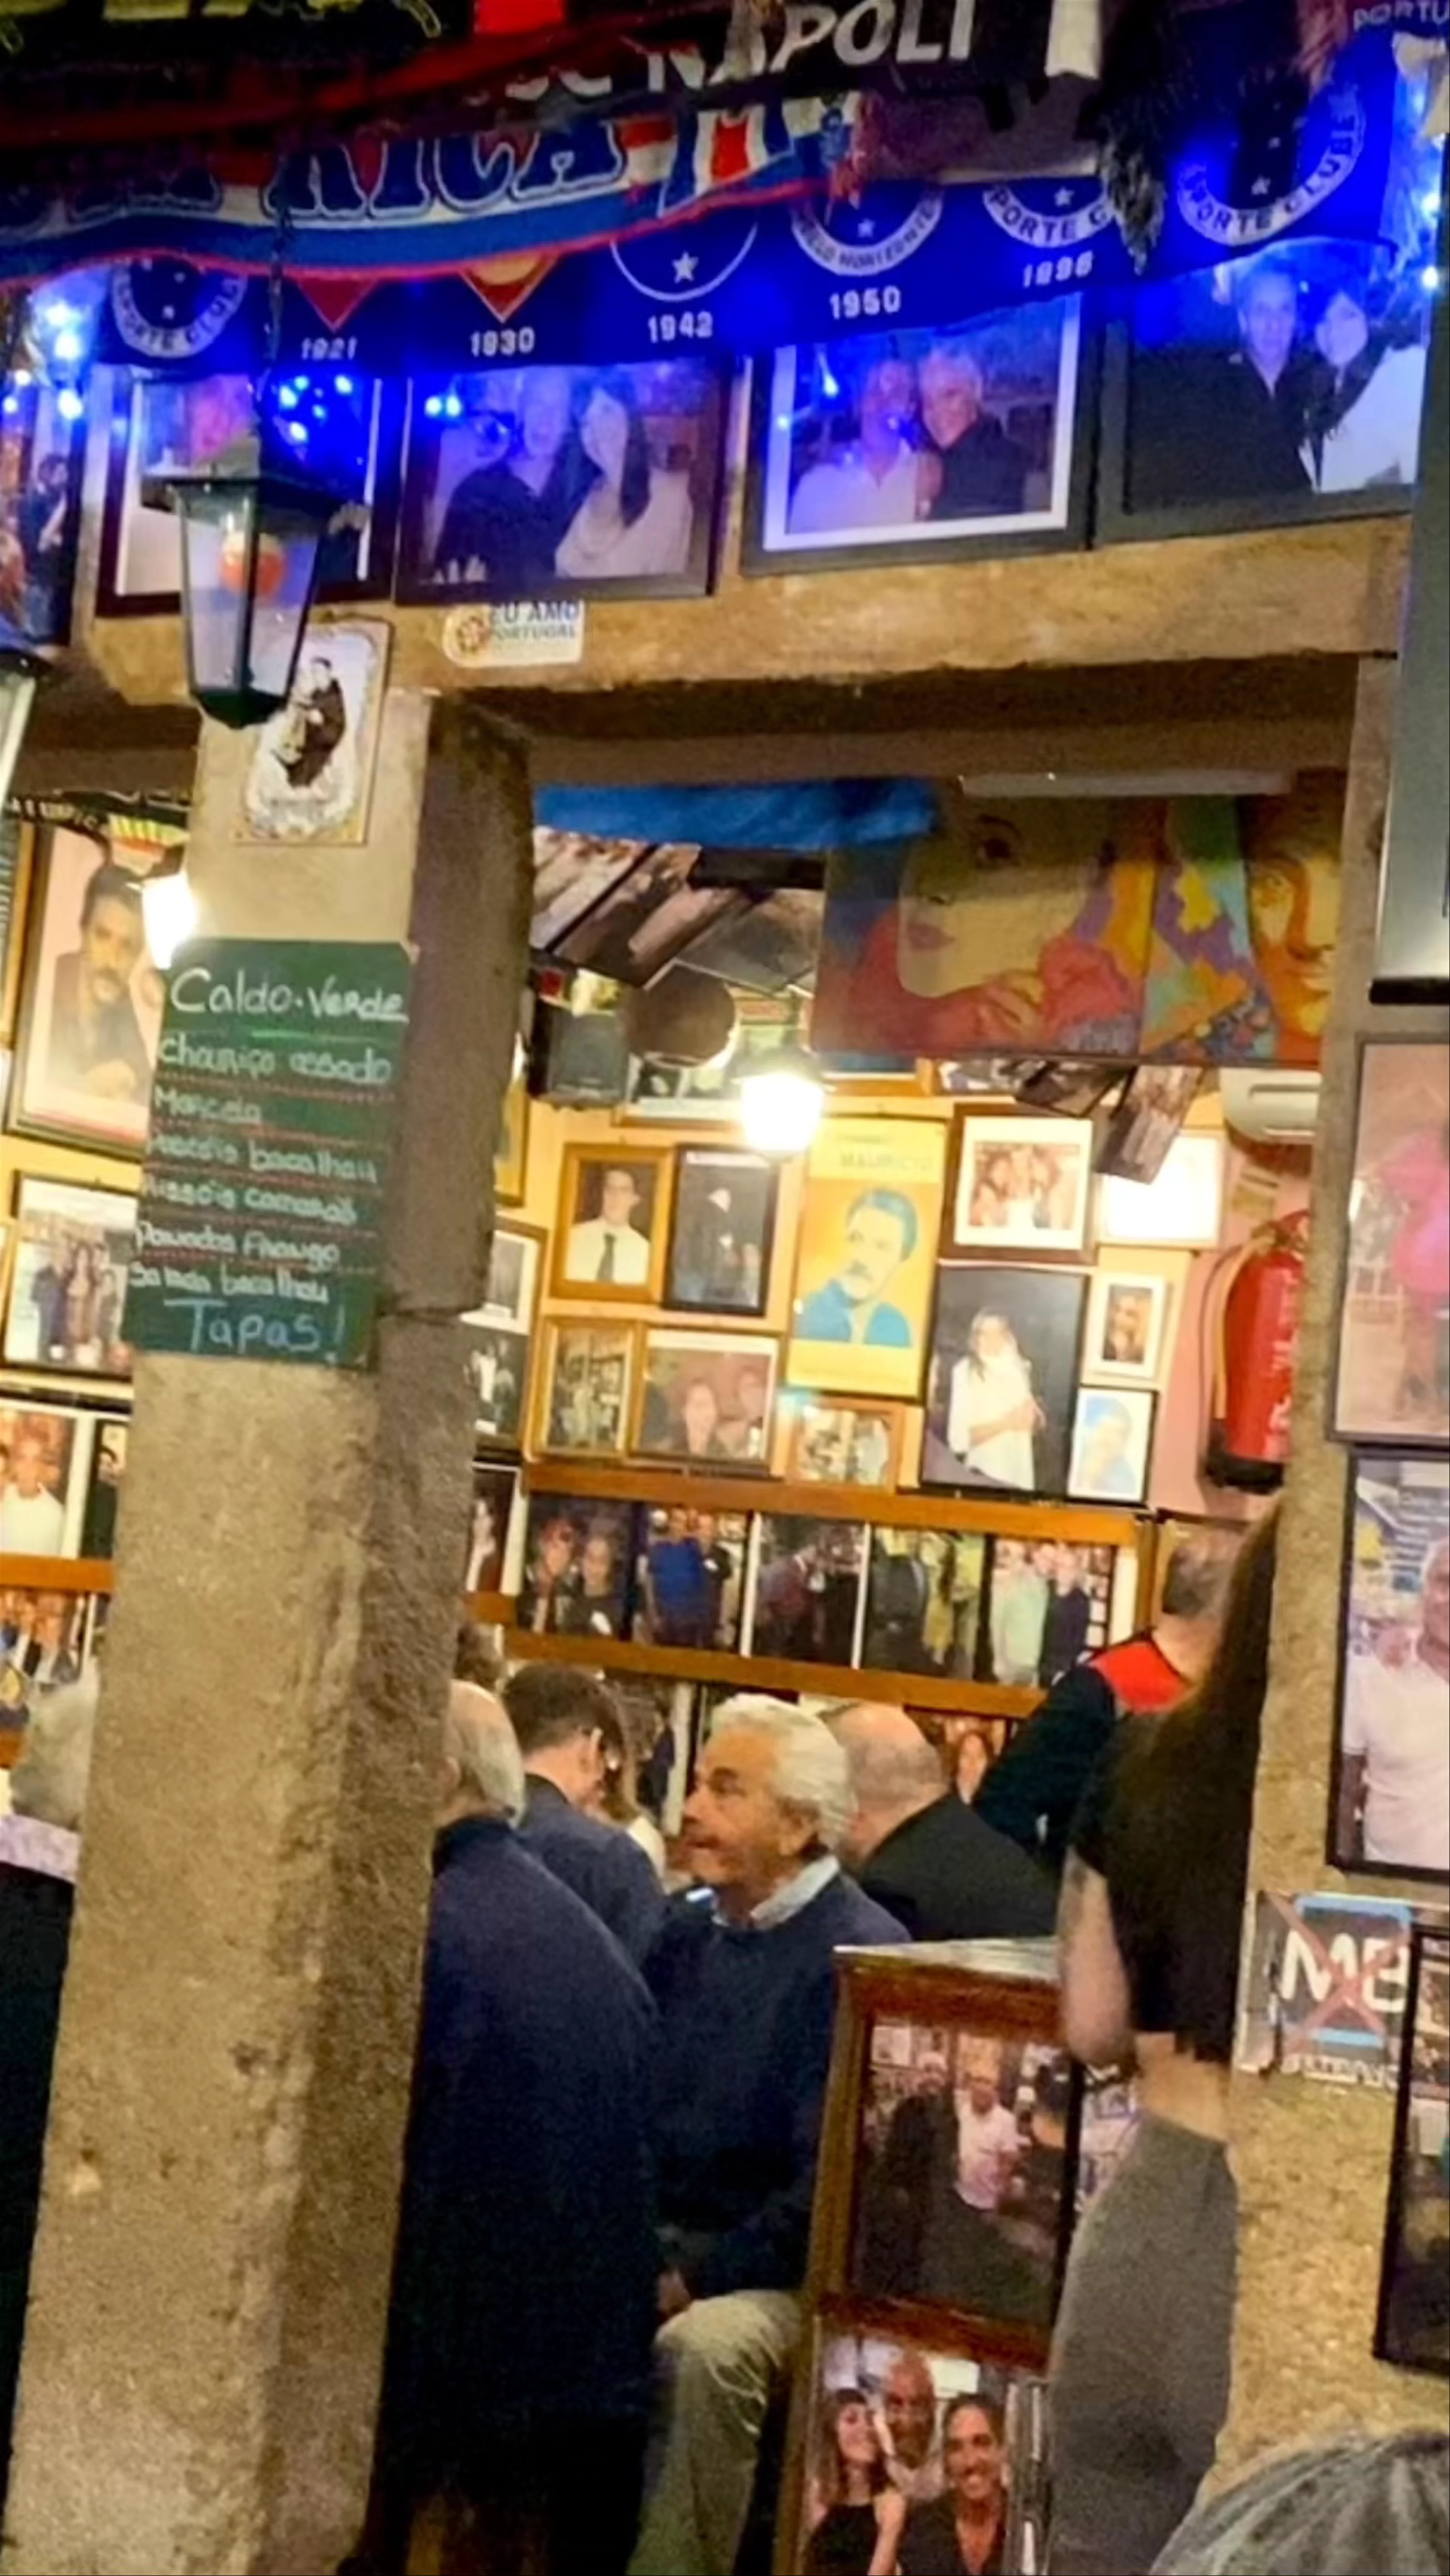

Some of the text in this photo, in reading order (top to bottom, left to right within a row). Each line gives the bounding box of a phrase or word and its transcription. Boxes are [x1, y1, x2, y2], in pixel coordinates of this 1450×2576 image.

[989, 189, 1079, 242] PORTE
[829, 284, 901, 320] 1950
[470, 326, 535, 358] 1930
[648, 310, 713, 344] 1942
[301, 336, 358, 361] 1921
